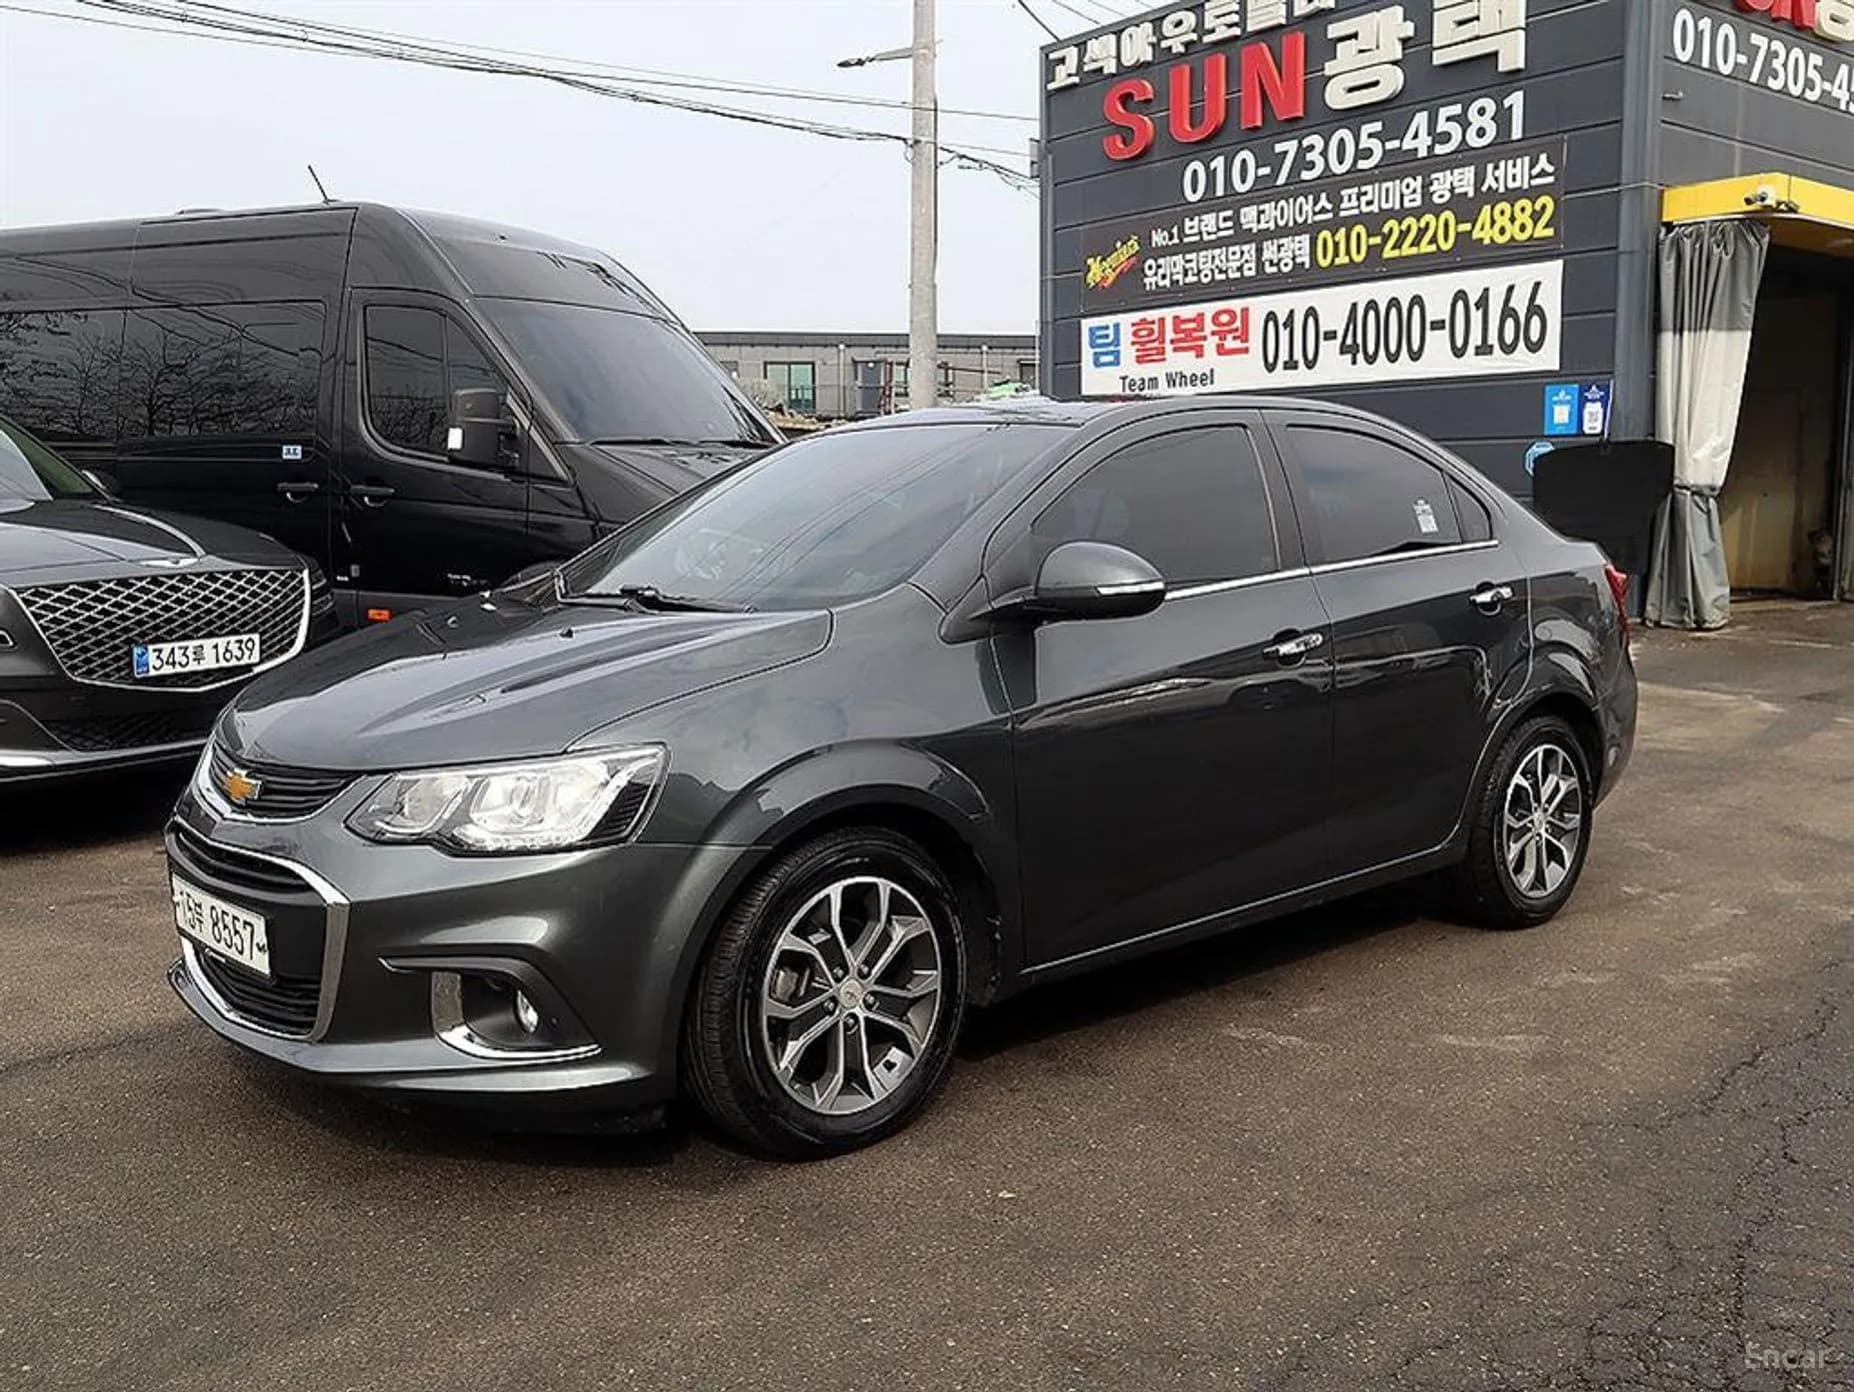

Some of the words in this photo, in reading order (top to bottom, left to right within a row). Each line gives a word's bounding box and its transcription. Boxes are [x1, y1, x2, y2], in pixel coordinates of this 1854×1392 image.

[1103, 31, 1305, 161] SUN
[1324, 0, 1528, 110] 광택
[1672, 8, 1854, 112] 010-7305-4
[1183, 90, 1526, 201] 010-7305-4581
[1151, 226, 1180, 248] No.1
[1183, 210, 1234, 243] 브랜드
[1339, 176, 1423, 217] 프리미엄
[1429, 165, 1475, 204] 광택
[1480, 152, 1555, 194] 서비스
[1316, 195, 1555, 269] 010-2220-4882
[1087, 322, 1122, 369] 팀
[1130, 307, 1250, 366] 휠복원
[1261, 281, 1548, 374] 010-4000-0166
[1119, 374, 1160, 393] Team
[1165, 367, 1216, 389] Wheel
[212, 638, 256, 664] 1639
[210, 905, 256, 961] 8557
